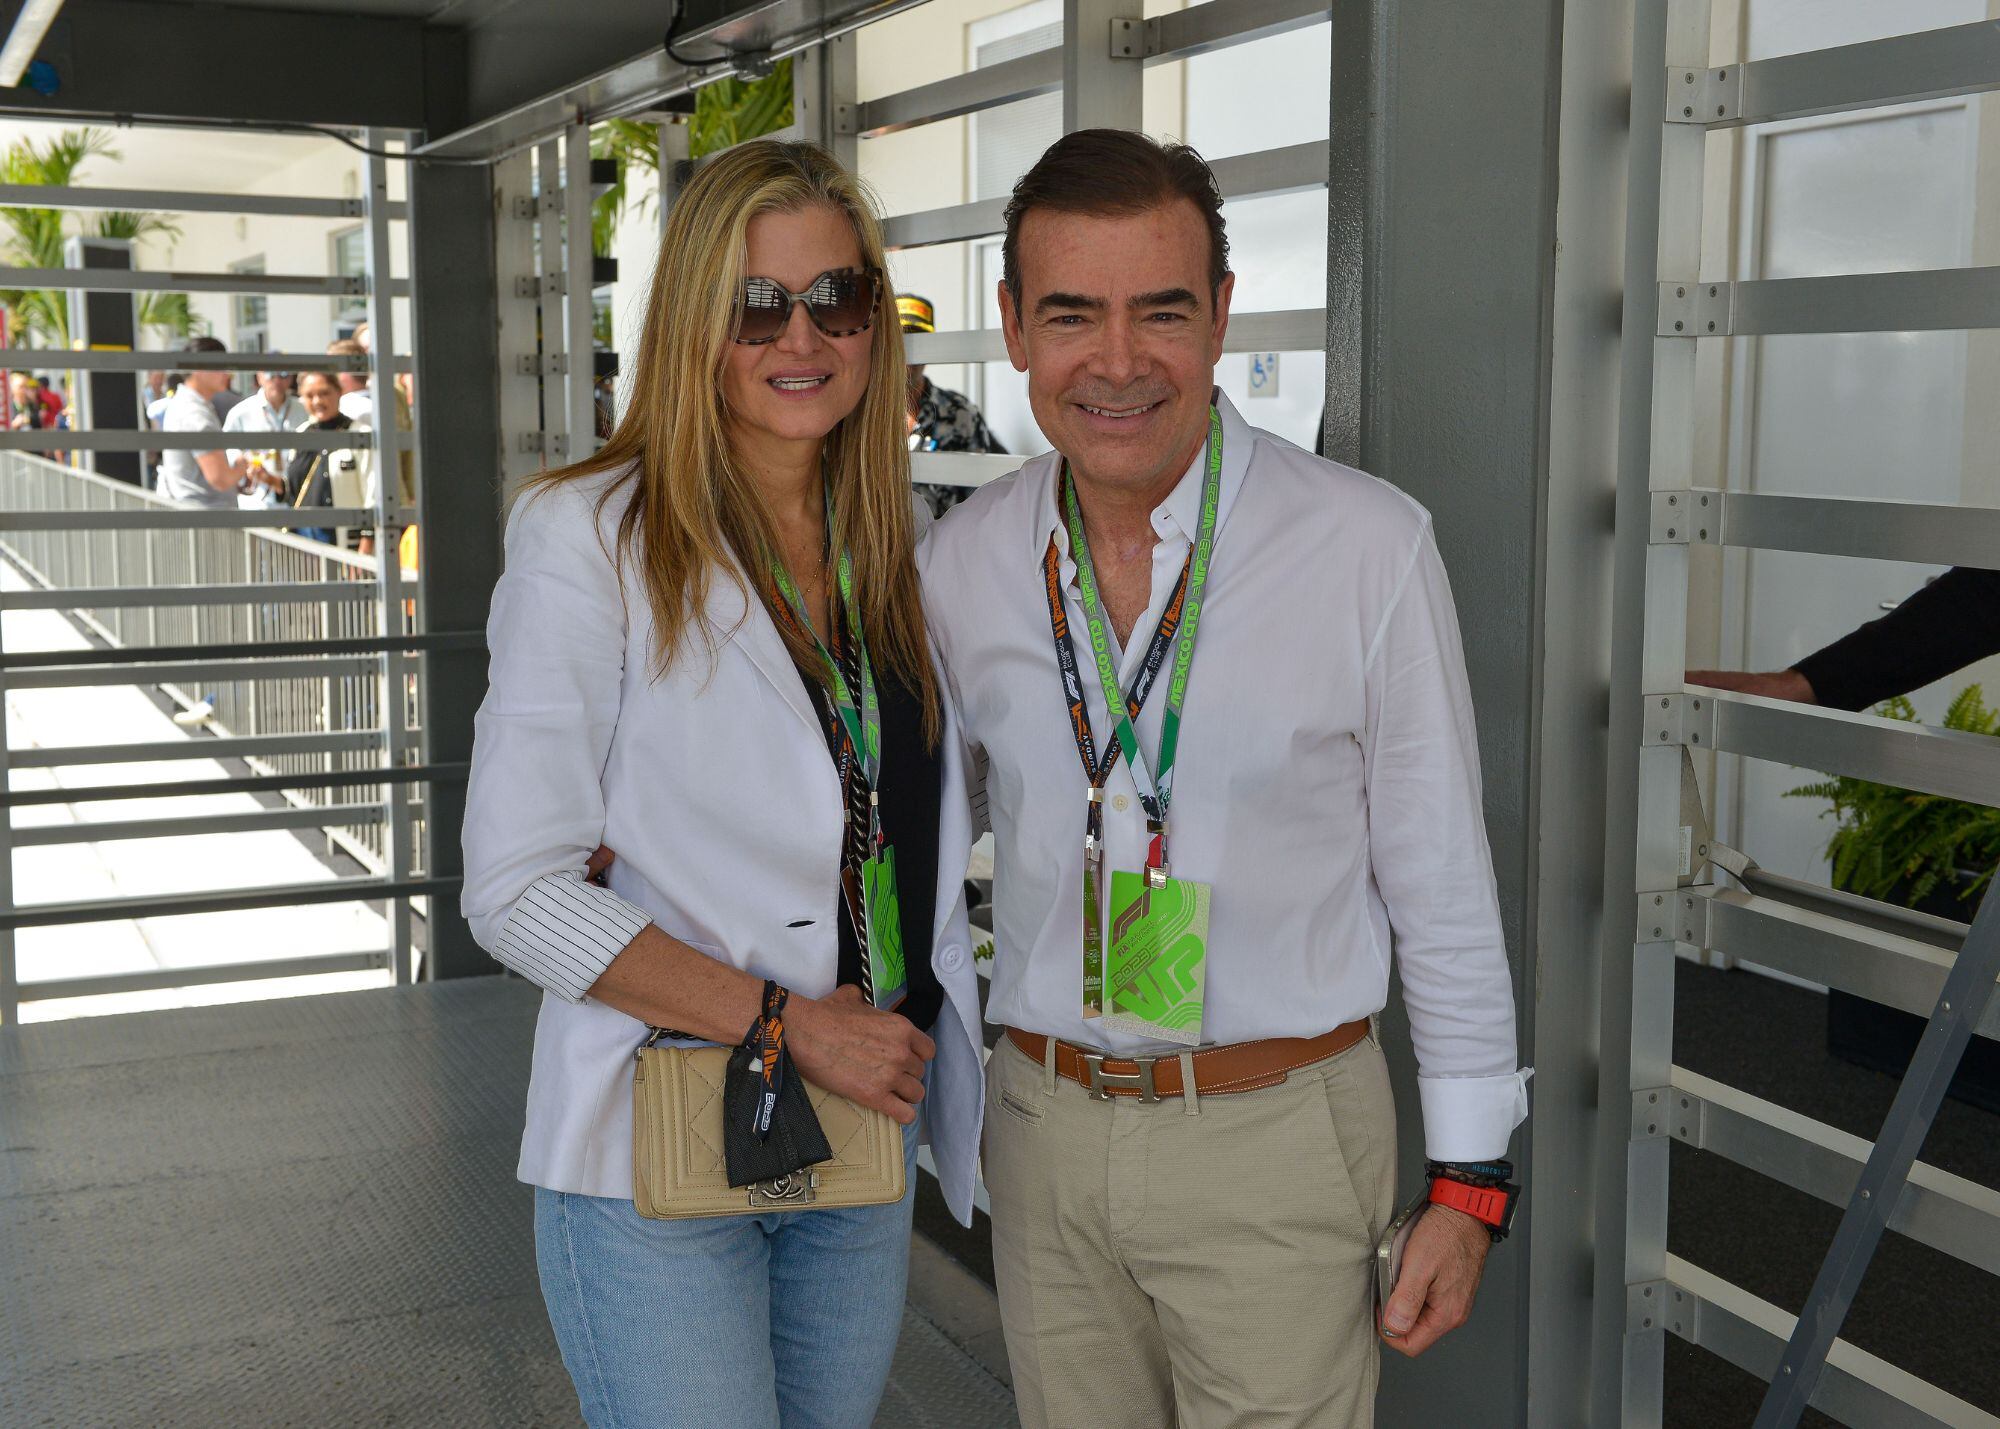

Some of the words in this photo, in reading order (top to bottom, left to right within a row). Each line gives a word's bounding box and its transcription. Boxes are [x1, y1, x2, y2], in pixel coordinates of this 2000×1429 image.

[1056, 638, 1068, 669] PADDOCK
[1088, 619, 1106, 653] CITY
[1147, 636, 1163, 666] PADDOCK
[1170, 639, 1193, 708] MEXICO
[1182, 601, 1199, 638] CITY
[1098, 653, 1125, 715] MEXICO
[840, 752, 849, 783] UNDAY
[1083, 735, 1097, 773] SUNDAY
[1103, 740, 1120, 772] SUNDA
[1112, 933, 1206, 1021] VIP
[761, 1092, 776, 1131] 2023
